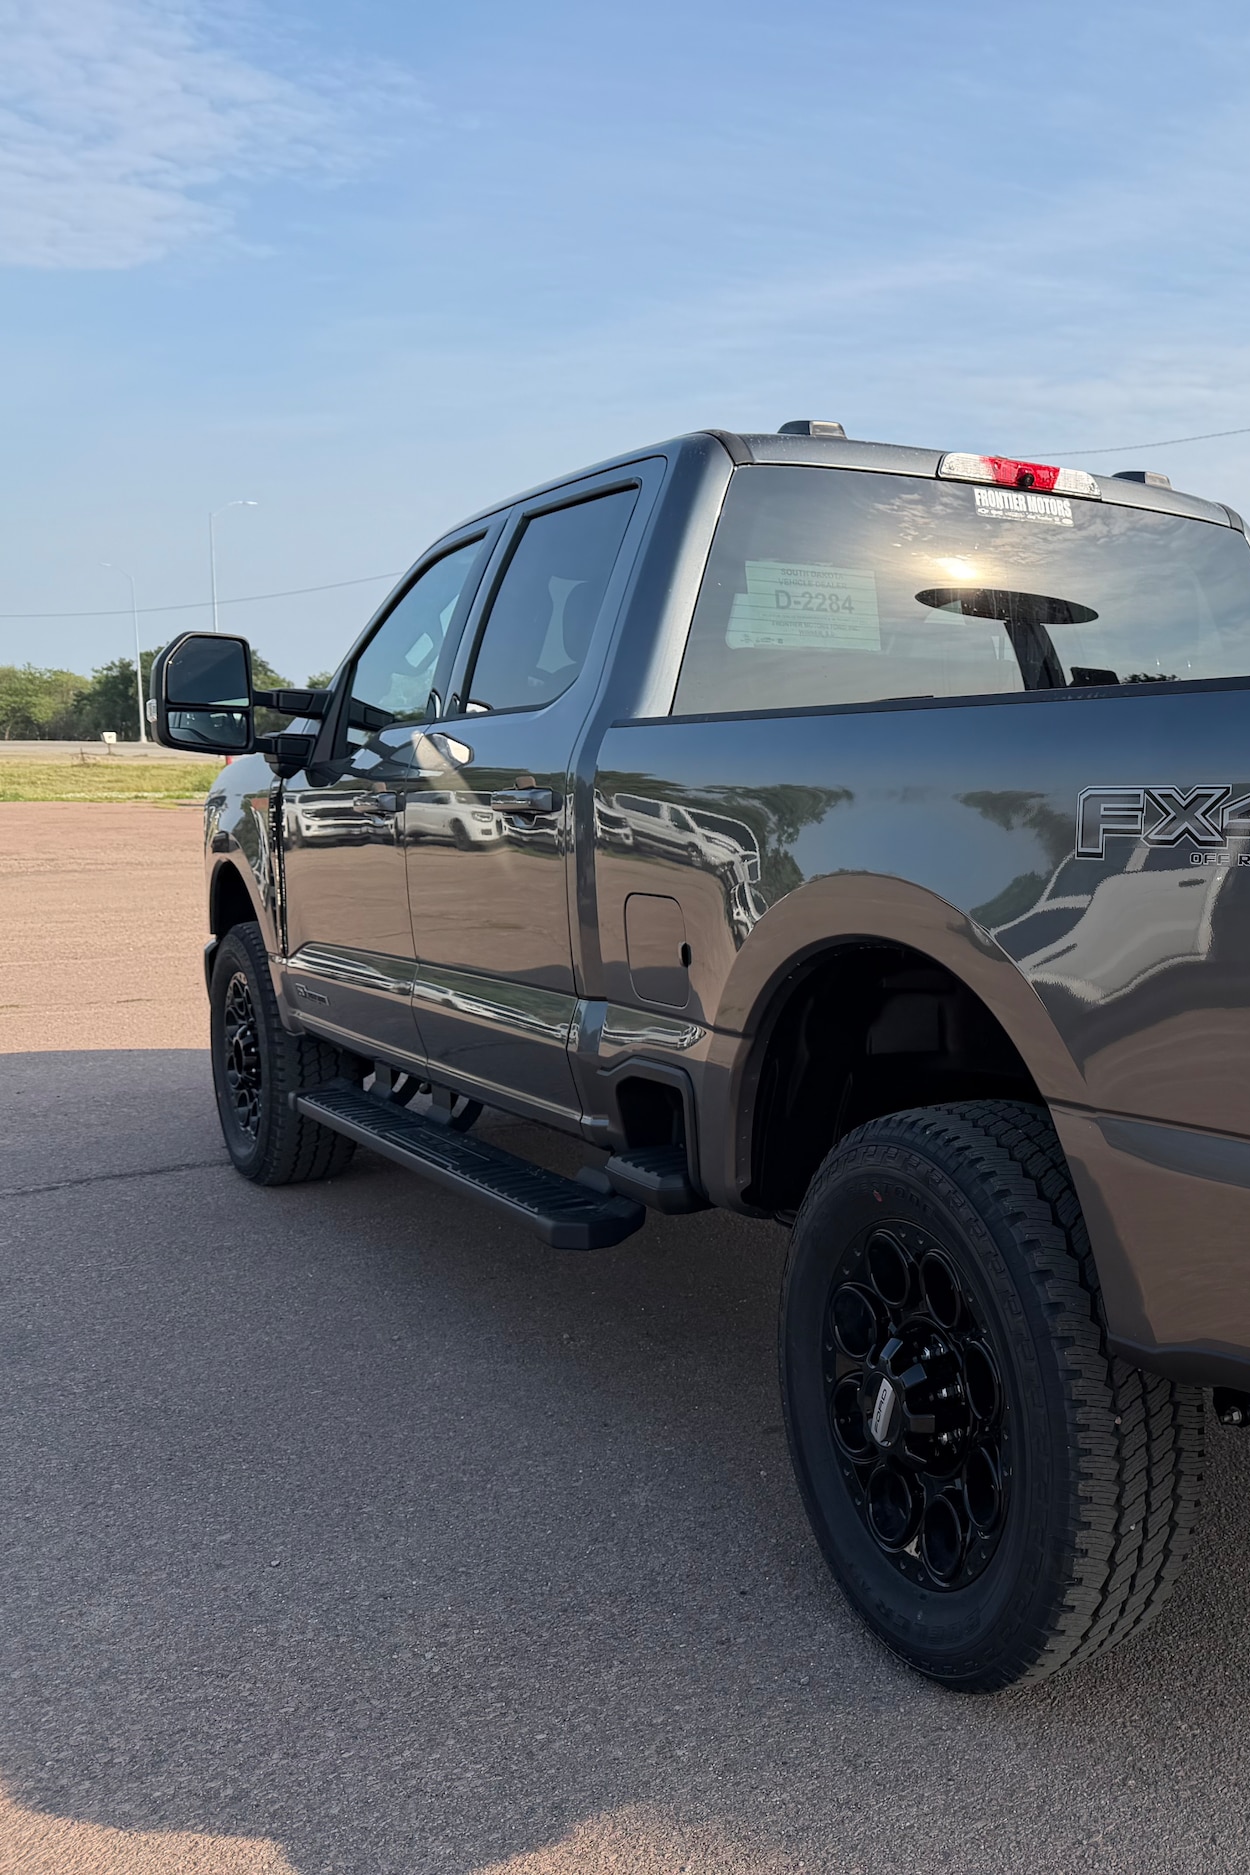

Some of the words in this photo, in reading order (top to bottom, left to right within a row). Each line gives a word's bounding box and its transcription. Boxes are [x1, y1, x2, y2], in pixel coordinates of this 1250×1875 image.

[974, 488, 1027, 512] FRONTIER
[1026, 495, 1073, 519] MOTORS
[777, 577, 813, 588] VEHICLE
[814, 580, 848, 590] DEALER
[780, 567, 809, 578] SOUTH
[810, 570, 844, 581] DAKOTA
[774, 589, 856, 615] D-2284
[1190, 852, 1230, 865] OFF
[874, 1388, 888, 1433] FORD
